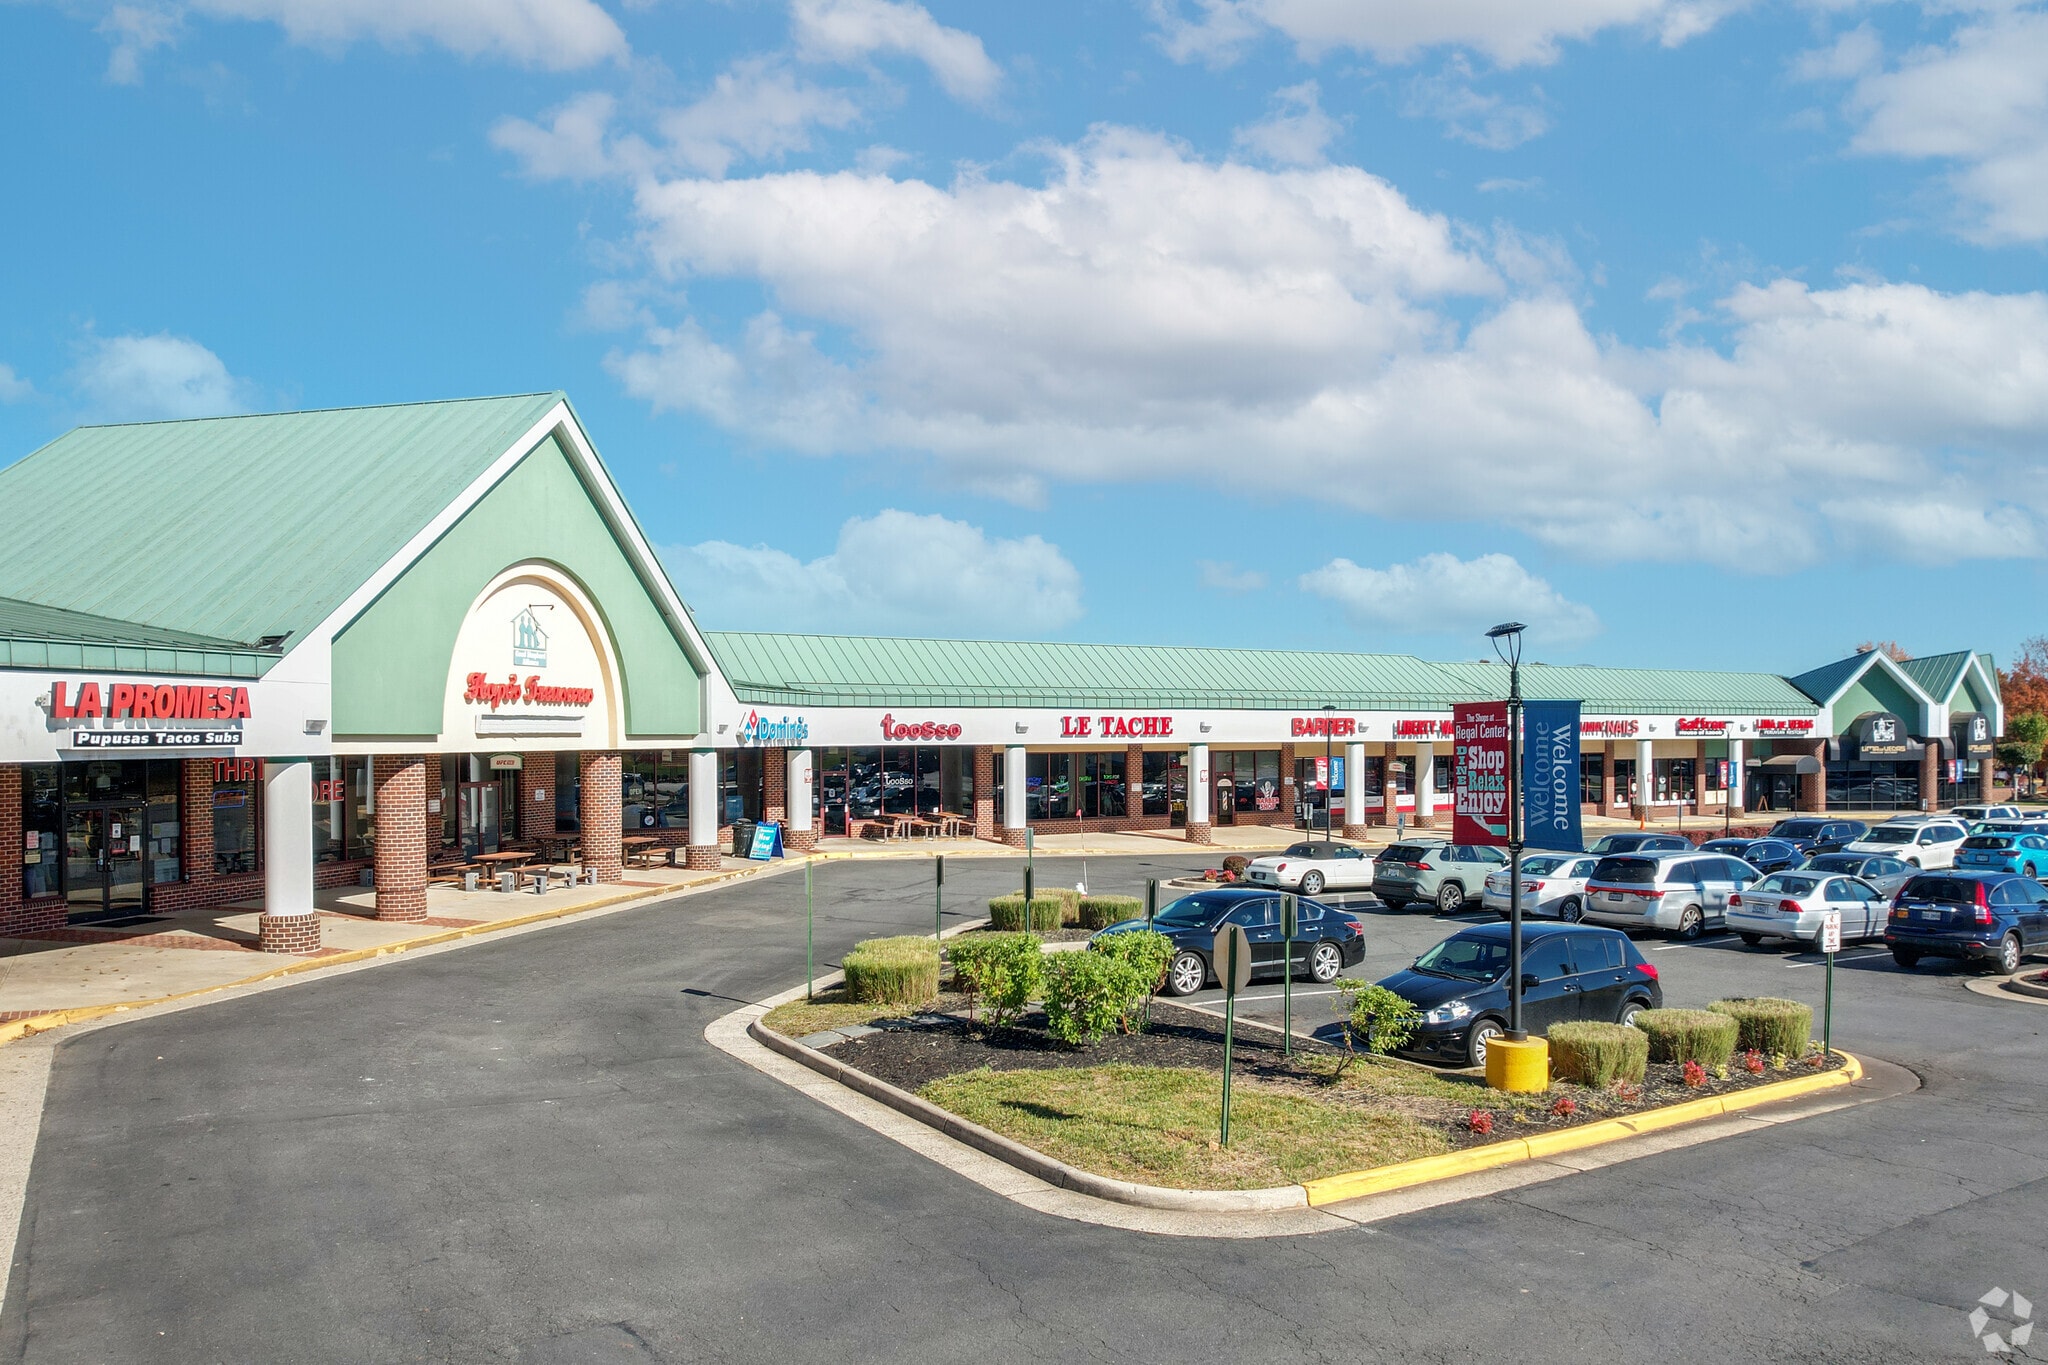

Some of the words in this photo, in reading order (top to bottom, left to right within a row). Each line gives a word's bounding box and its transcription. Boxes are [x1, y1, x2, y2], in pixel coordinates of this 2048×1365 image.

[52, 681, 103, 719] LA
[109, 683, 252, 719] PROMESA
[758, 716, 809, 739] Domino's
[1062, 716, 1092, 735] LE
[1100, 716, 1174, 736] TACHE
[1292, 717, 1356, 735] BARBER
[1466, 713, 1476, 722] The
[1476, 713, 1488, 723] Shops
[1580, 721, 1605, 732] UNNY
[1605, 719, 1639, 734] NAILS
[1677, 717, 1727, 730] Saffron
[77, 732, 150, 747] Pupusas
[155, 732, 200, 744] Tacos
[205, 732, 240, 744] Subs
[1455, 723, 1478, 742] Regal
[1480, 724, 1507, 739] Center
[212, 757, 265, 782] THRI
[1468, 745, 1505, 774] Shop
[1468, 771, 1506, 791] Relax
[1529, 721, 1551, 827] Welcome
[1552, 722, 1573, 830] Welcome
[1456, 786, 1507, 813] Enjoy
